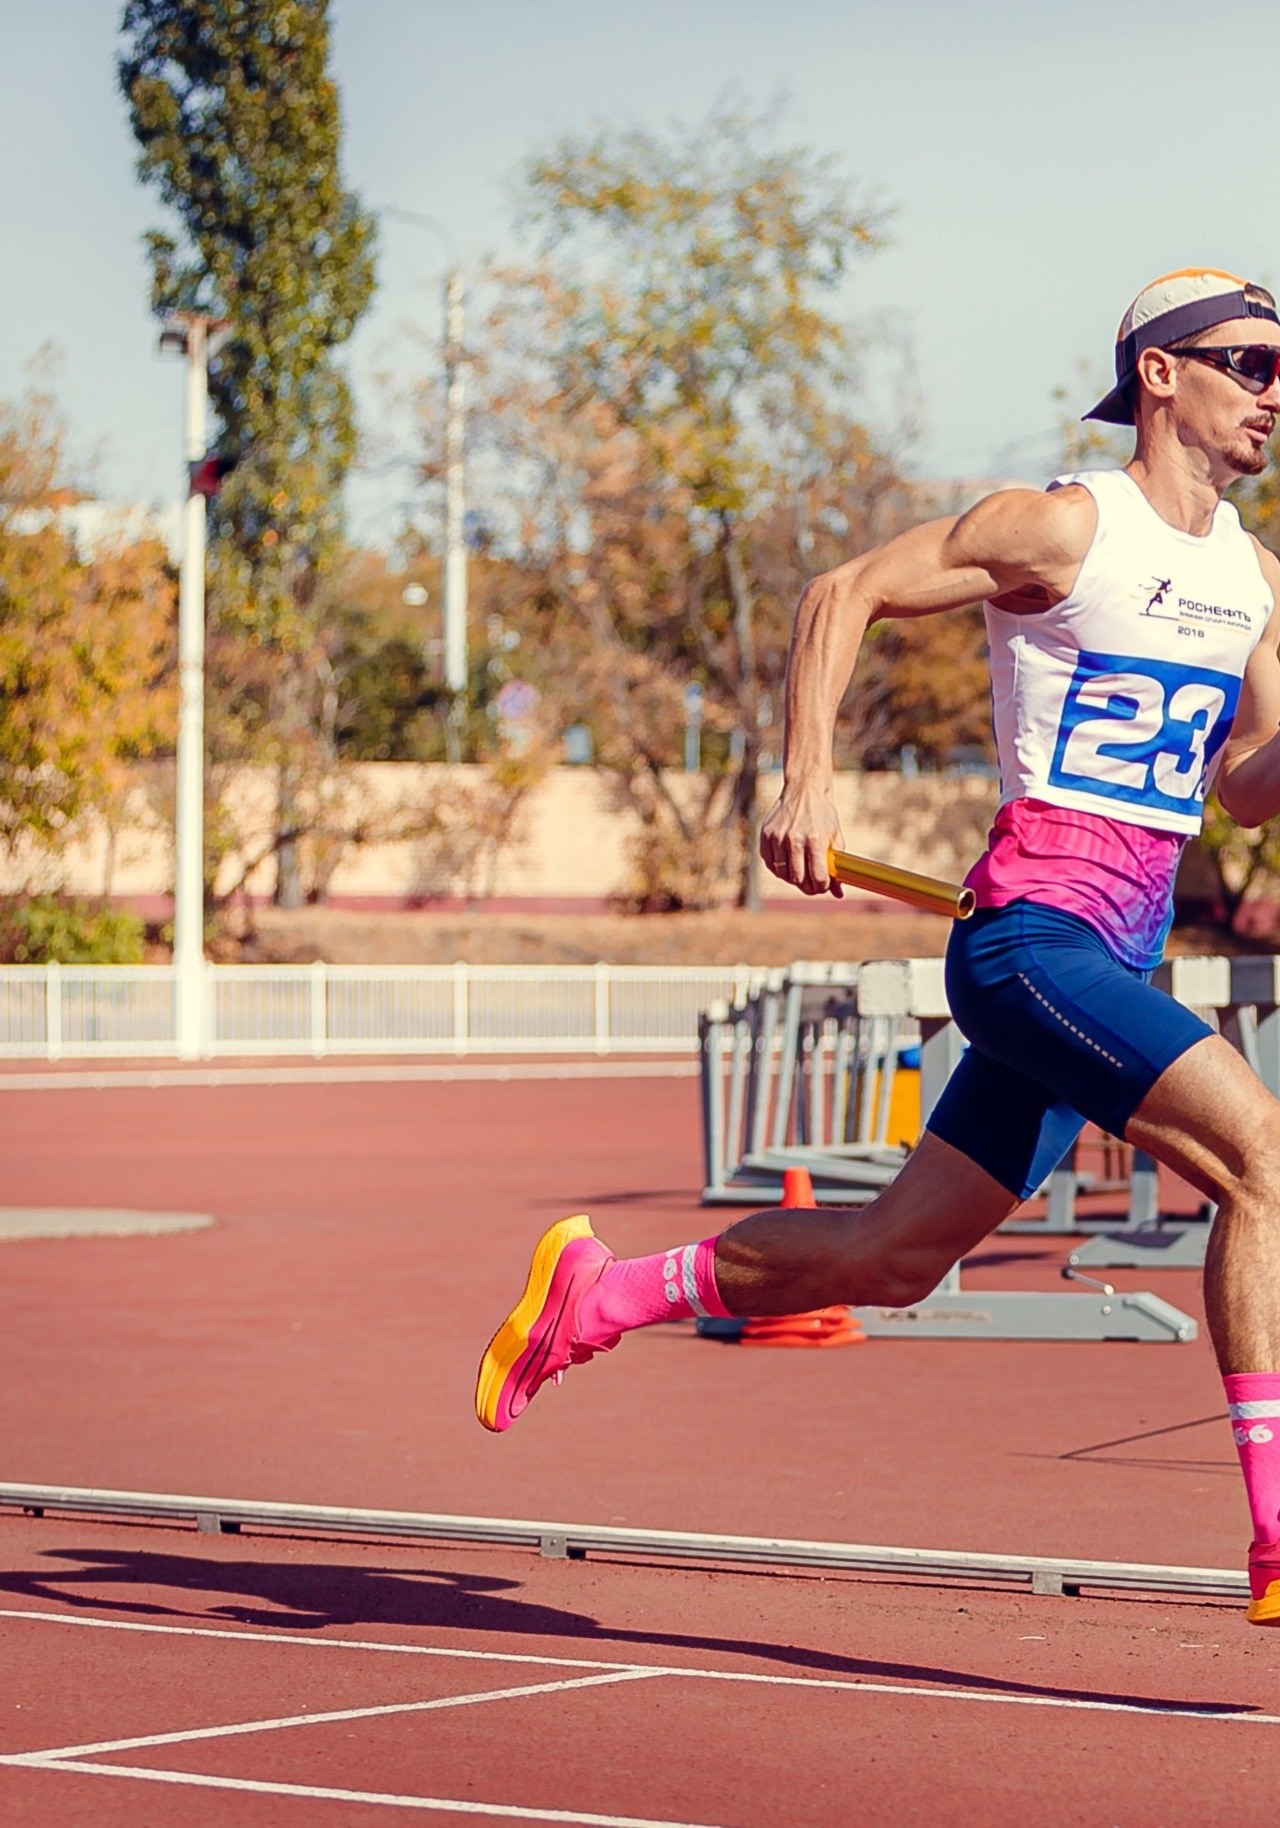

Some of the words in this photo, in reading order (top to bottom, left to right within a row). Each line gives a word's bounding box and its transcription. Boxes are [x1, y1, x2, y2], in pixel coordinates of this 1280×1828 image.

[1178, 598, 1251, 623] РОСНЕФТЬ
[1177, 625, 1205, 638] 2018
[1060, 672, 1226, 800] 23
